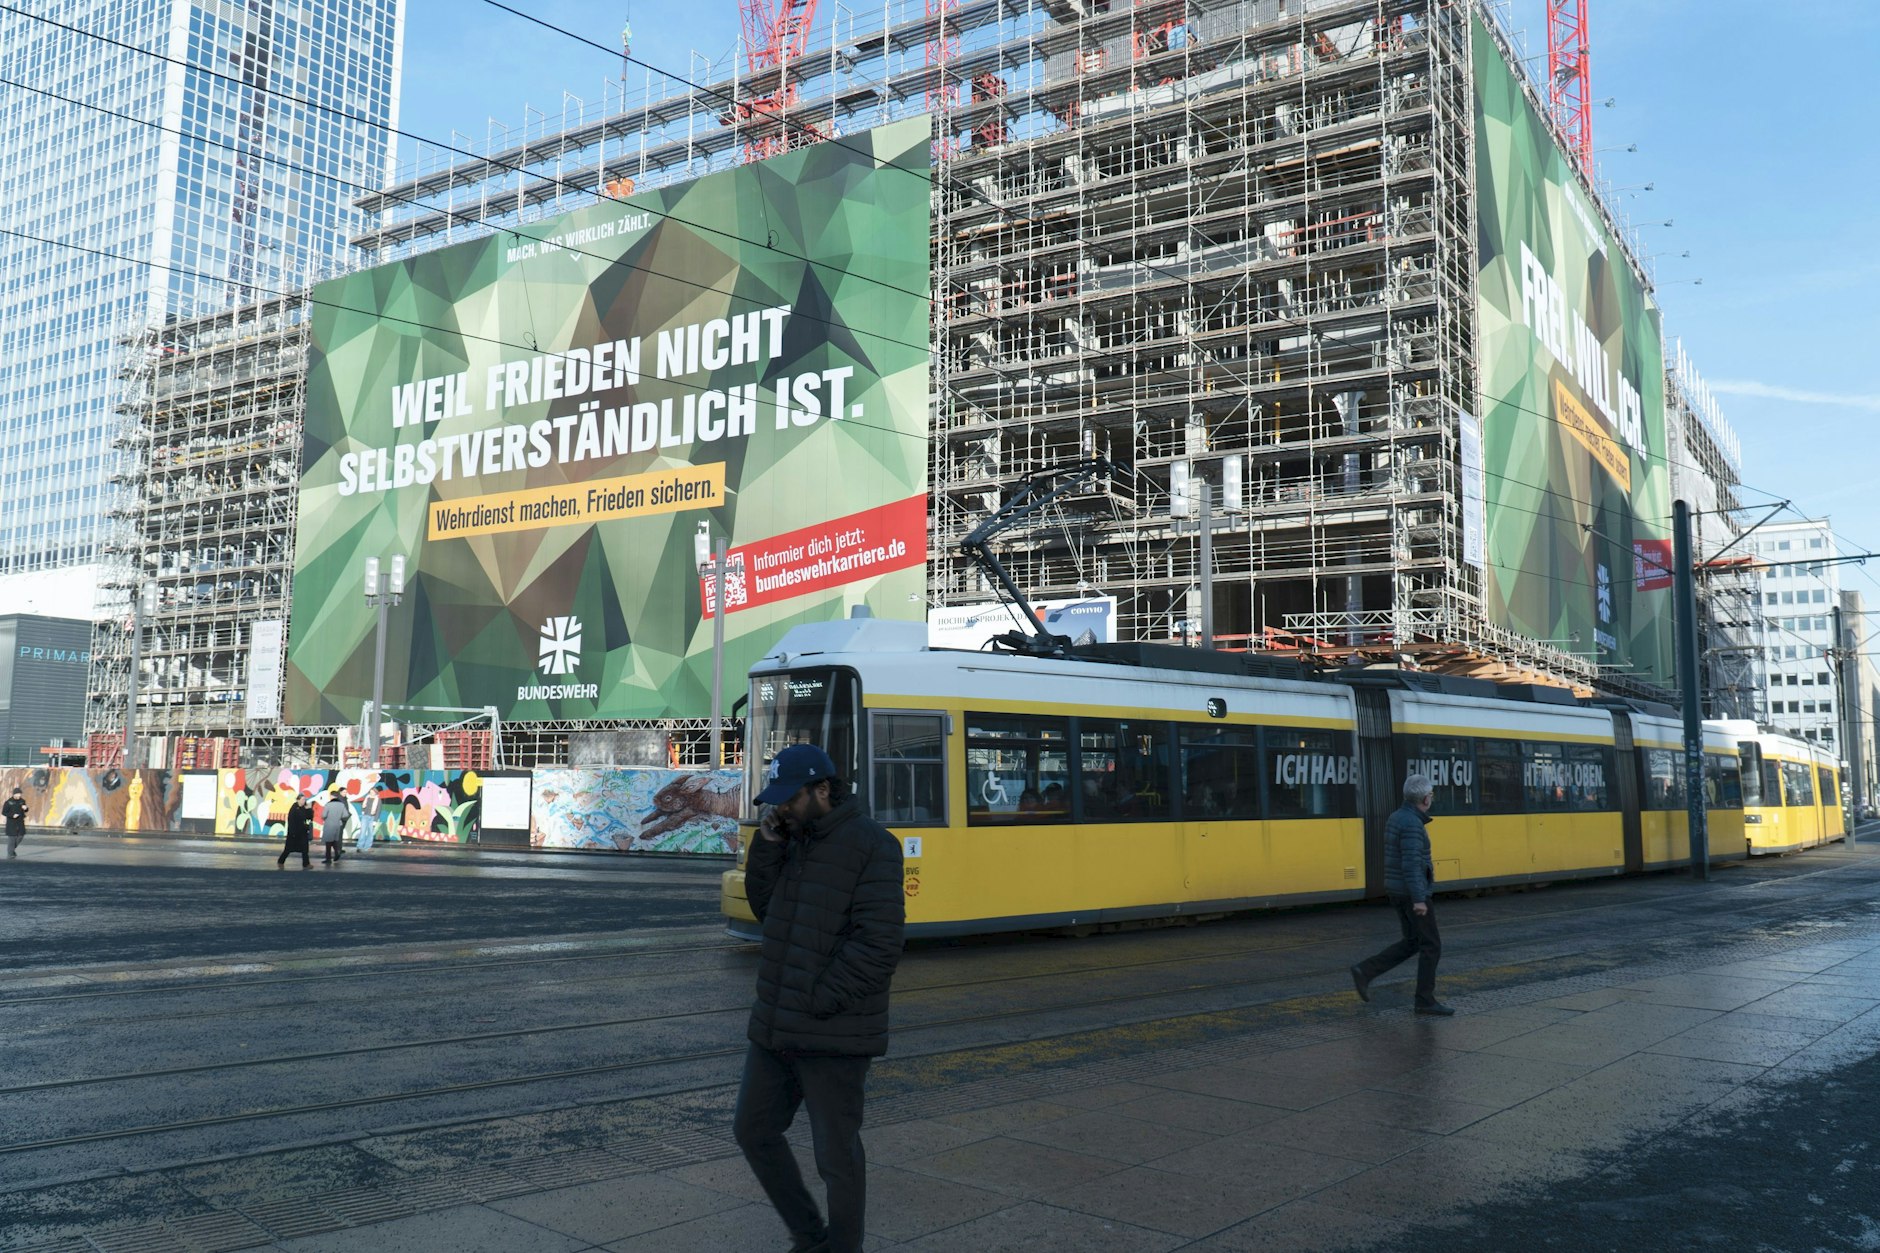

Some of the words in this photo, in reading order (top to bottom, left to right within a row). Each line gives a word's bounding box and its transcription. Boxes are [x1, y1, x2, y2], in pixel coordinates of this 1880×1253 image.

[507, 243, 537, 263] MACH,
[540, 236, 563, 254] WAS
[566, 221, 615, 247] WIRKLICH
[618, 212, 651, 235] ZÄHLT.
[391, 371, 473, 428] WEIL
[486, 336, 641, 411] FRIEDEN
[656, 304, 792, 380] NICHT
[1572, 308, 1618, 429] WILL.
[1617, 369, 1646, 461] ICH.
[337, 383, 757, 497] SELBSTVERSTÄNDLICH
[775, 365, 864, 430] IST.
[436, 501, 515, 532] Wehrdienst
[519, 495, 581, 522] machen,
[587, 486, 645, 514] Frieden
[651, 478, 716, 506] sichern.
[753, 545, 805, 572] Informier
[807, 535, 833, 557] dich
[835, 528, 866, 553] jetzt:
[755, 539, 906, 593] bundeswehrkarriere.de
[517, 683, 598, 700] BUNDESWEHR
[1275, 754, 1309, 785] ICH
[905, 867, 920, 875] BVG
